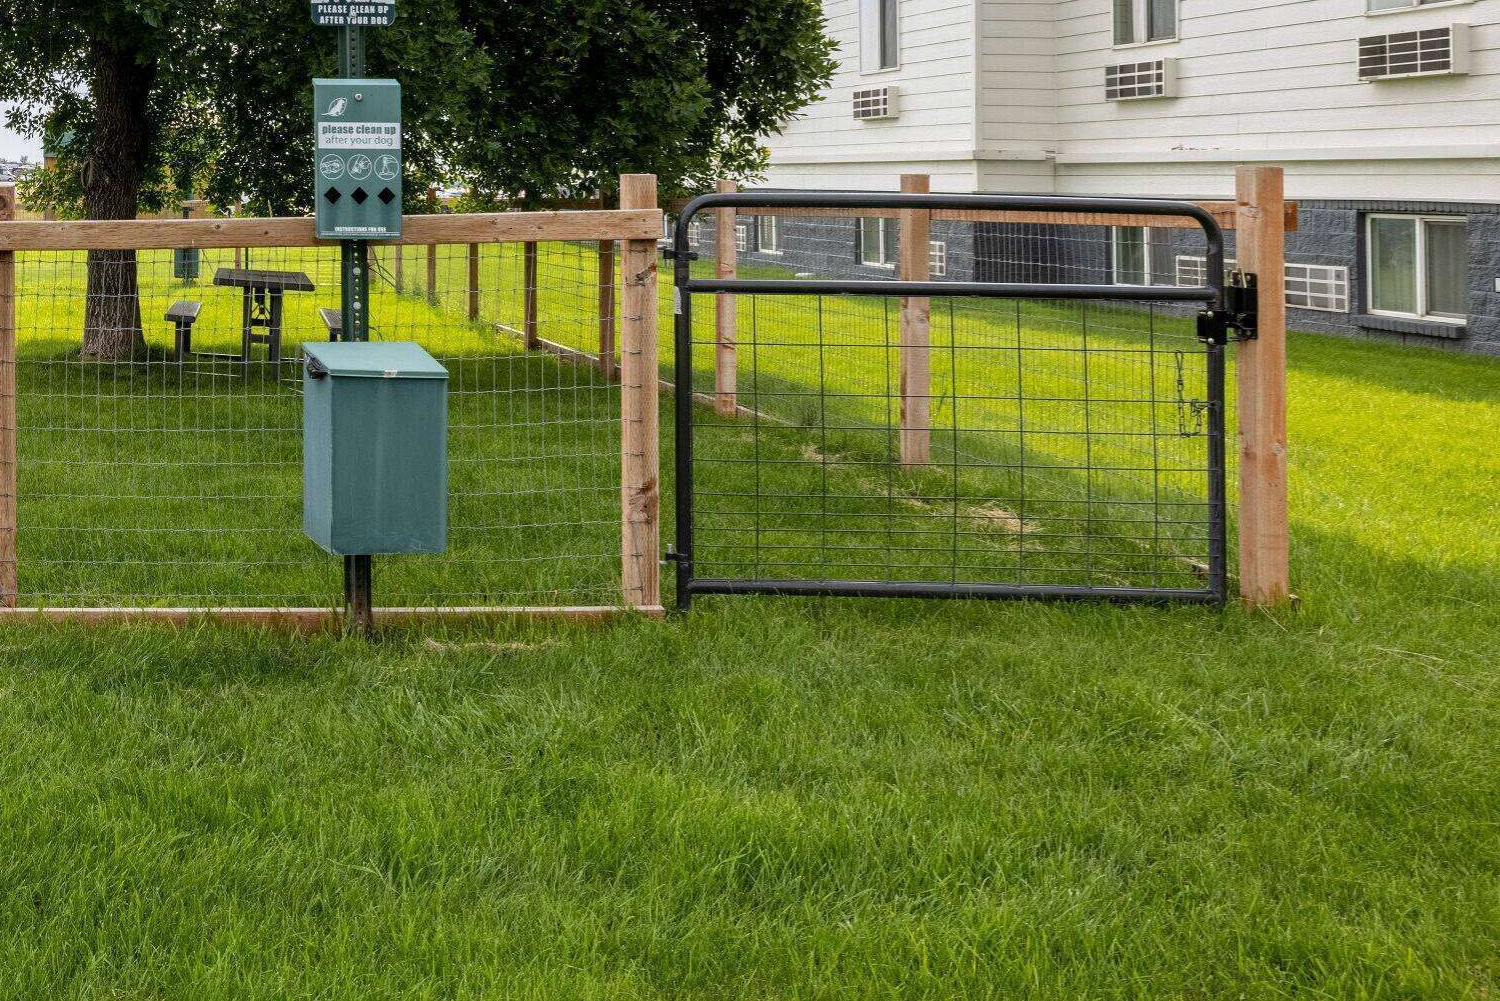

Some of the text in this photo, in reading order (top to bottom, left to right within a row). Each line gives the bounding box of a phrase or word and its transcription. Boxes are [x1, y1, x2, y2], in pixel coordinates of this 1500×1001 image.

[318, 5, 389, 14] PLEASE CLEAN UP
[319, 16, 388, 25] AFTER YOUR DOG
[322, 125, 396, 135] please clean up
[325, 136, 393, 146] after your dog
